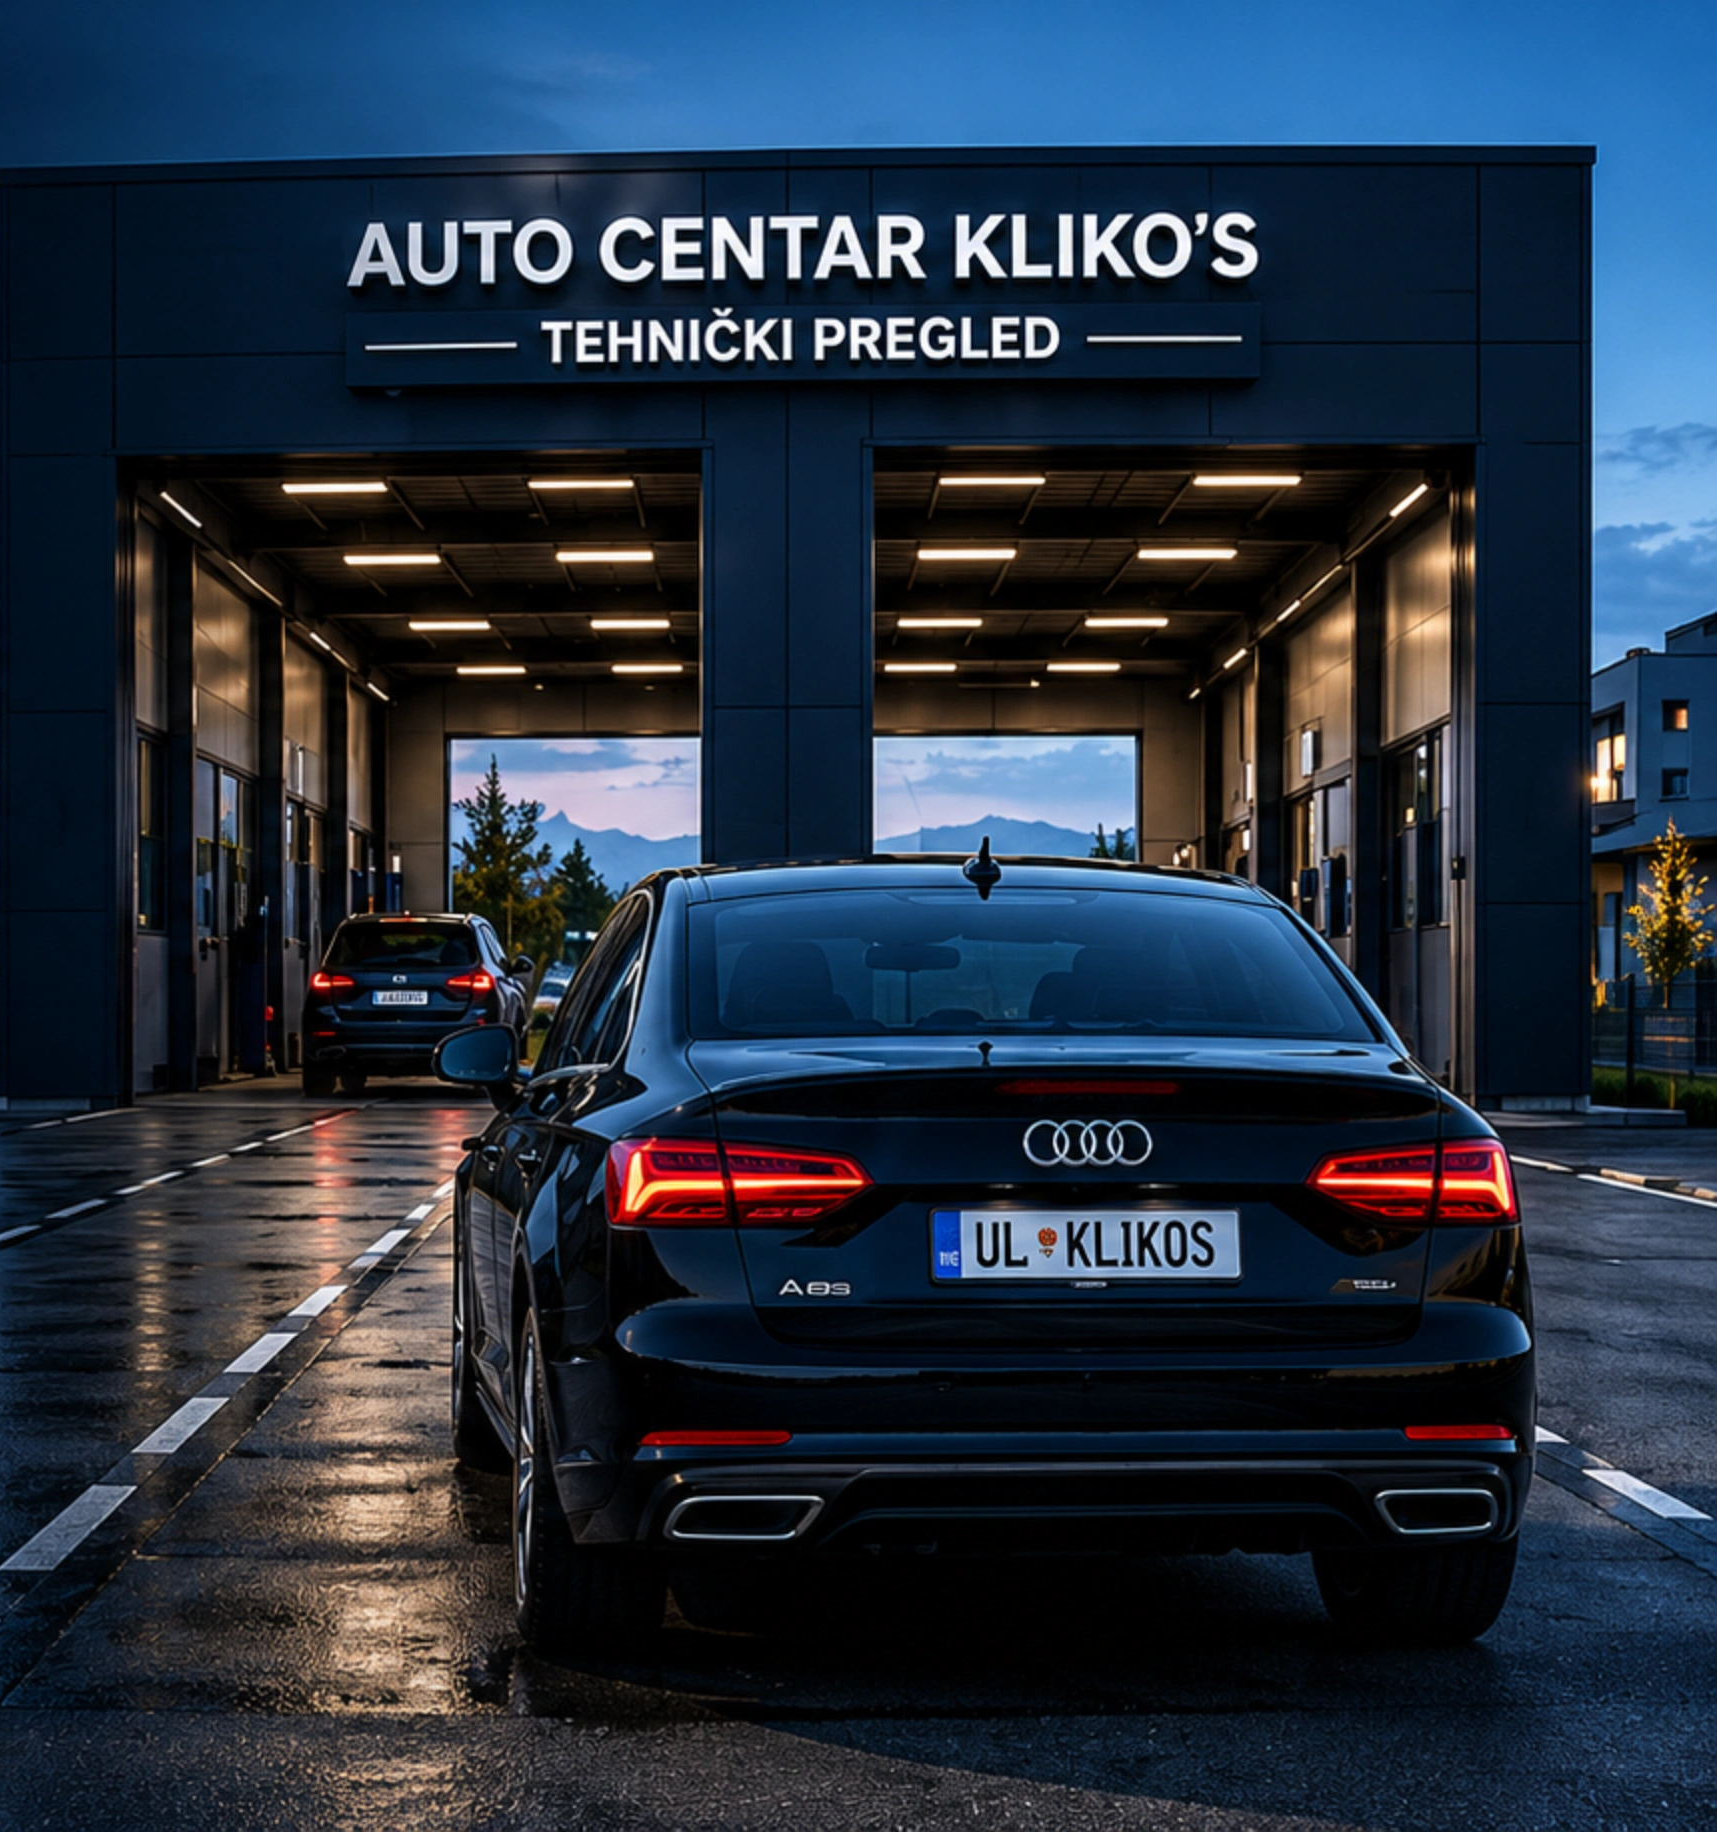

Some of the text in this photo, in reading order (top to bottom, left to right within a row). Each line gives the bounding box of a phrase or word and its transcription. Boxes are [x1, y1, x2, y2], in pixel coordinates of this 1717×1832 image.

[347, 211, 1260, 287] AUTO CENTAR KLIKO’S
[539, 307, 1061, 364] TEHNIČKI PREGLED
[975, 1219, 1215, 1269] UL KLIKOS
